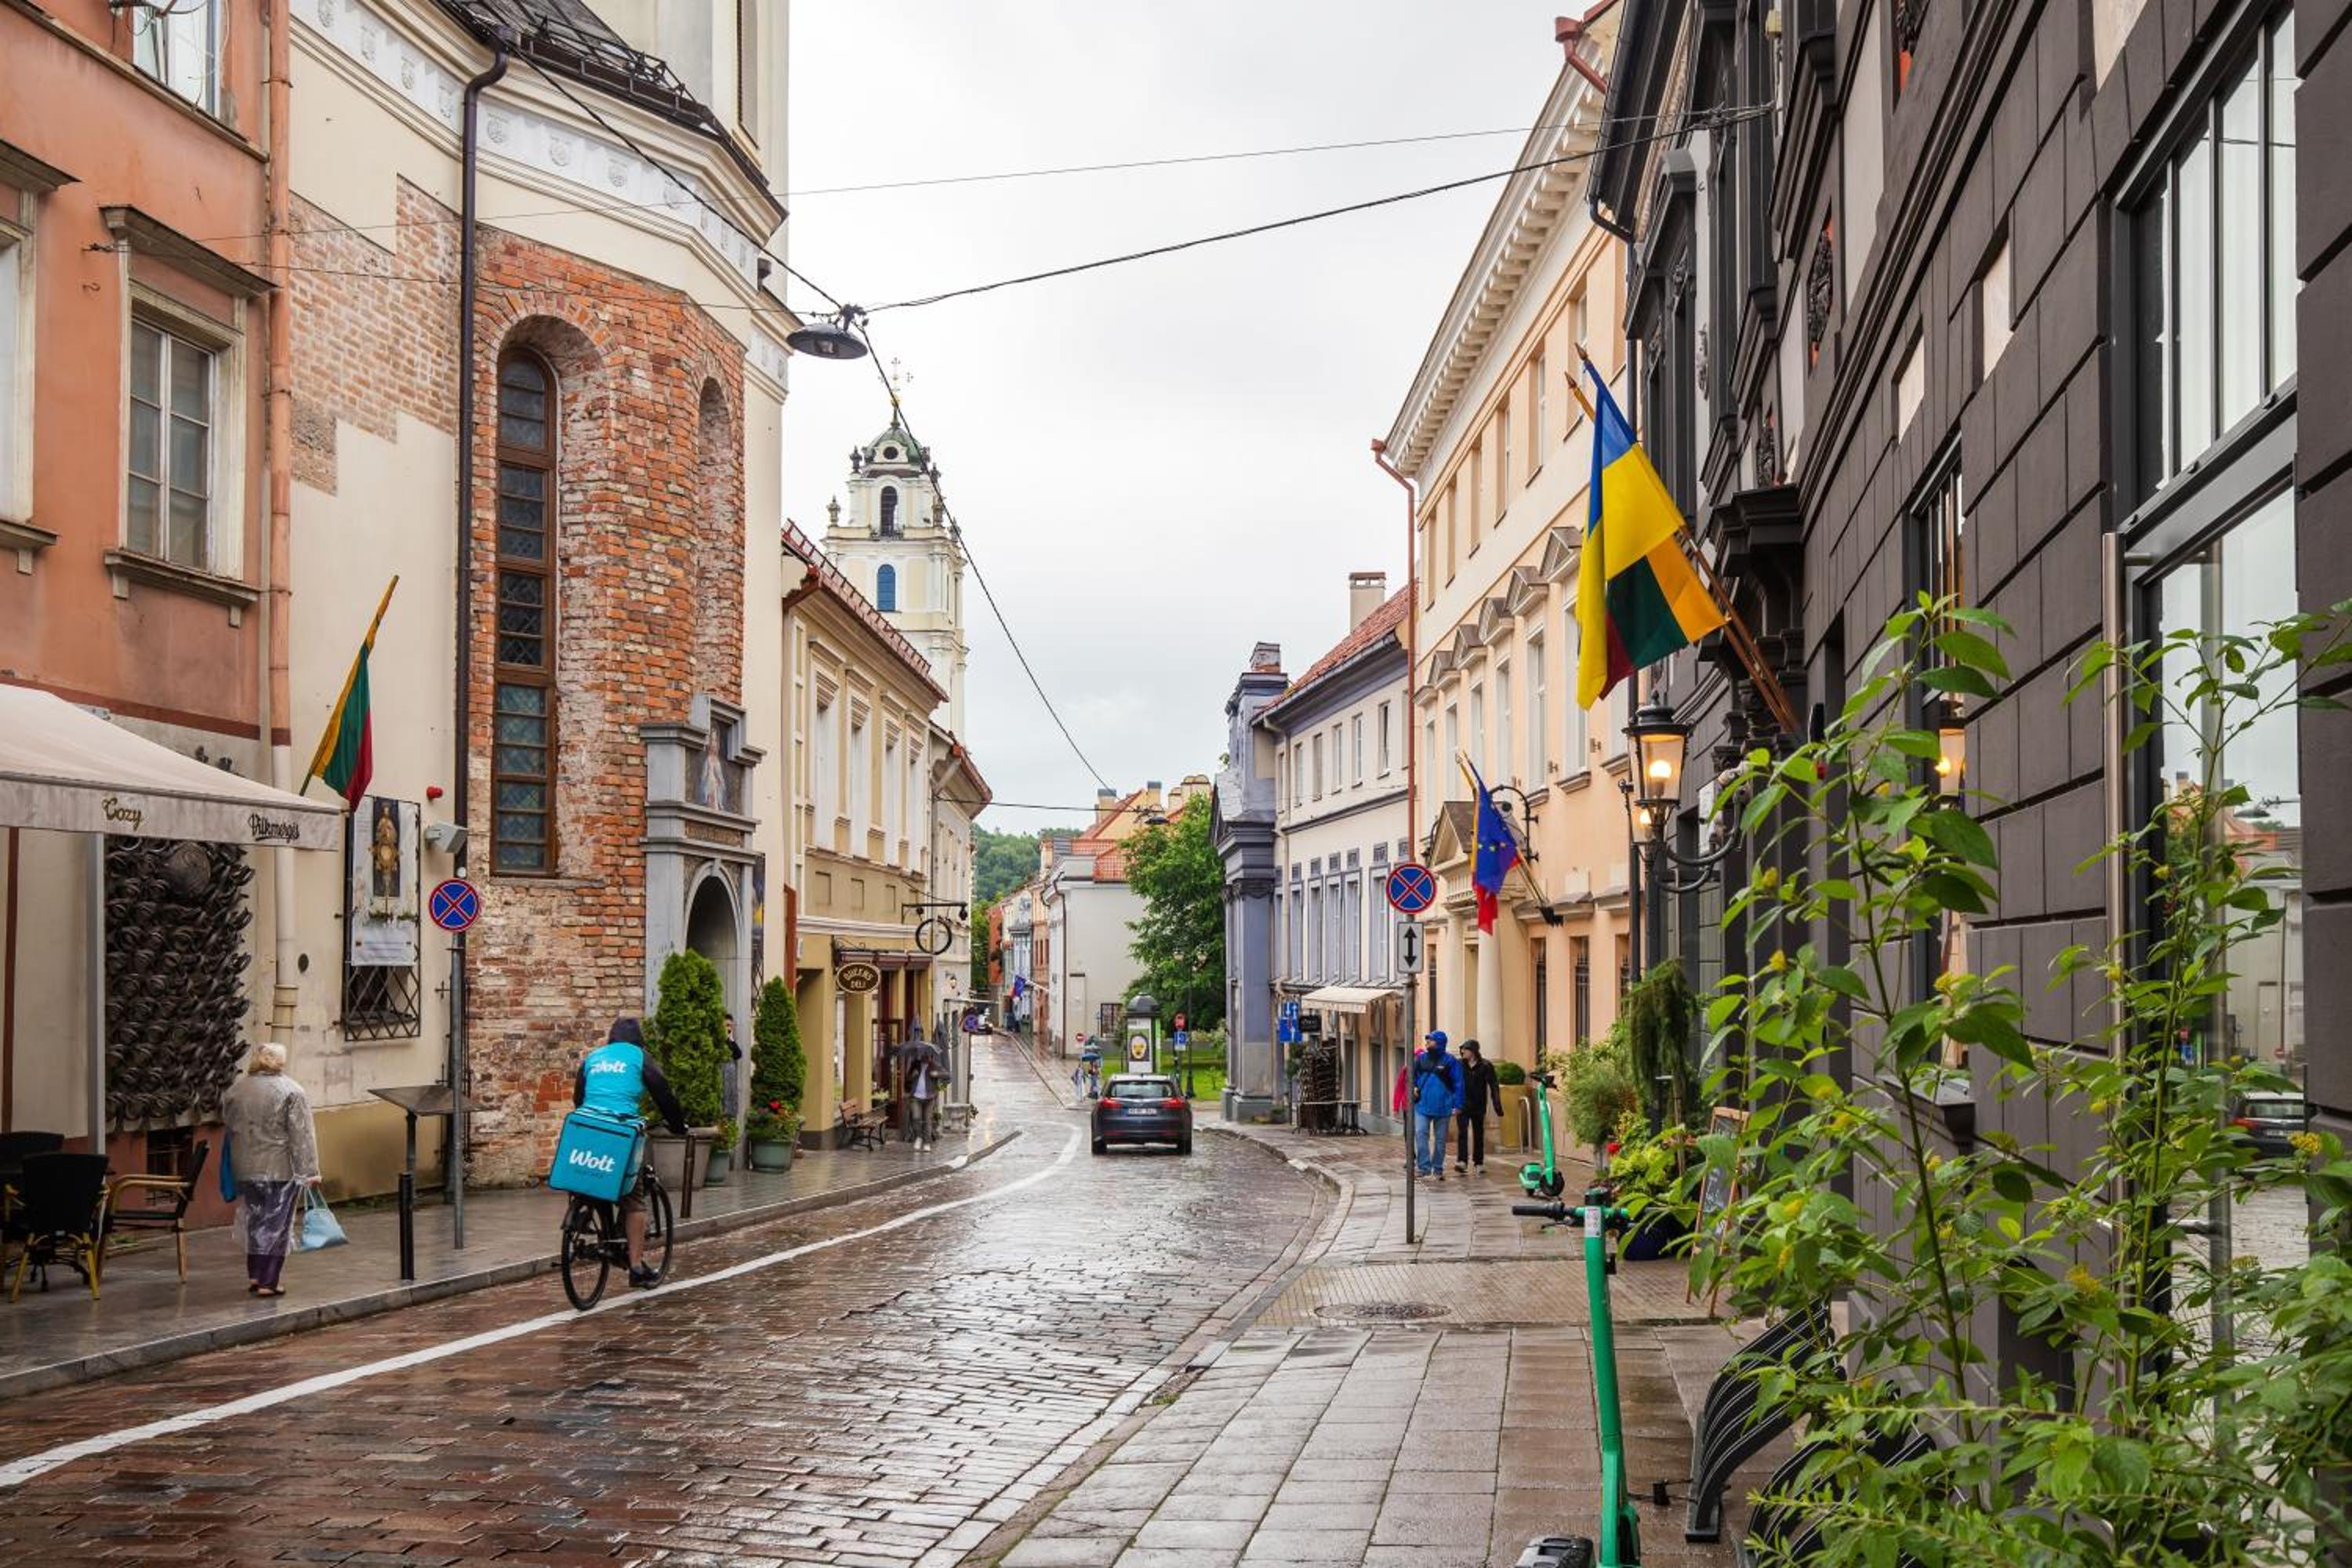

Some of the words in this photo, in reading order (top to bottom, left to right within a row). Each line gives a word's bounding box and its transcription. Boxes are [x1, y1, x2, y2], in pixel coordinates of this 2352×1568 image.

[102, 797, 142, 831] Cozy
[851, 980, 866, 989] DELI
[569, 1149, 615, 1172] Wolt
